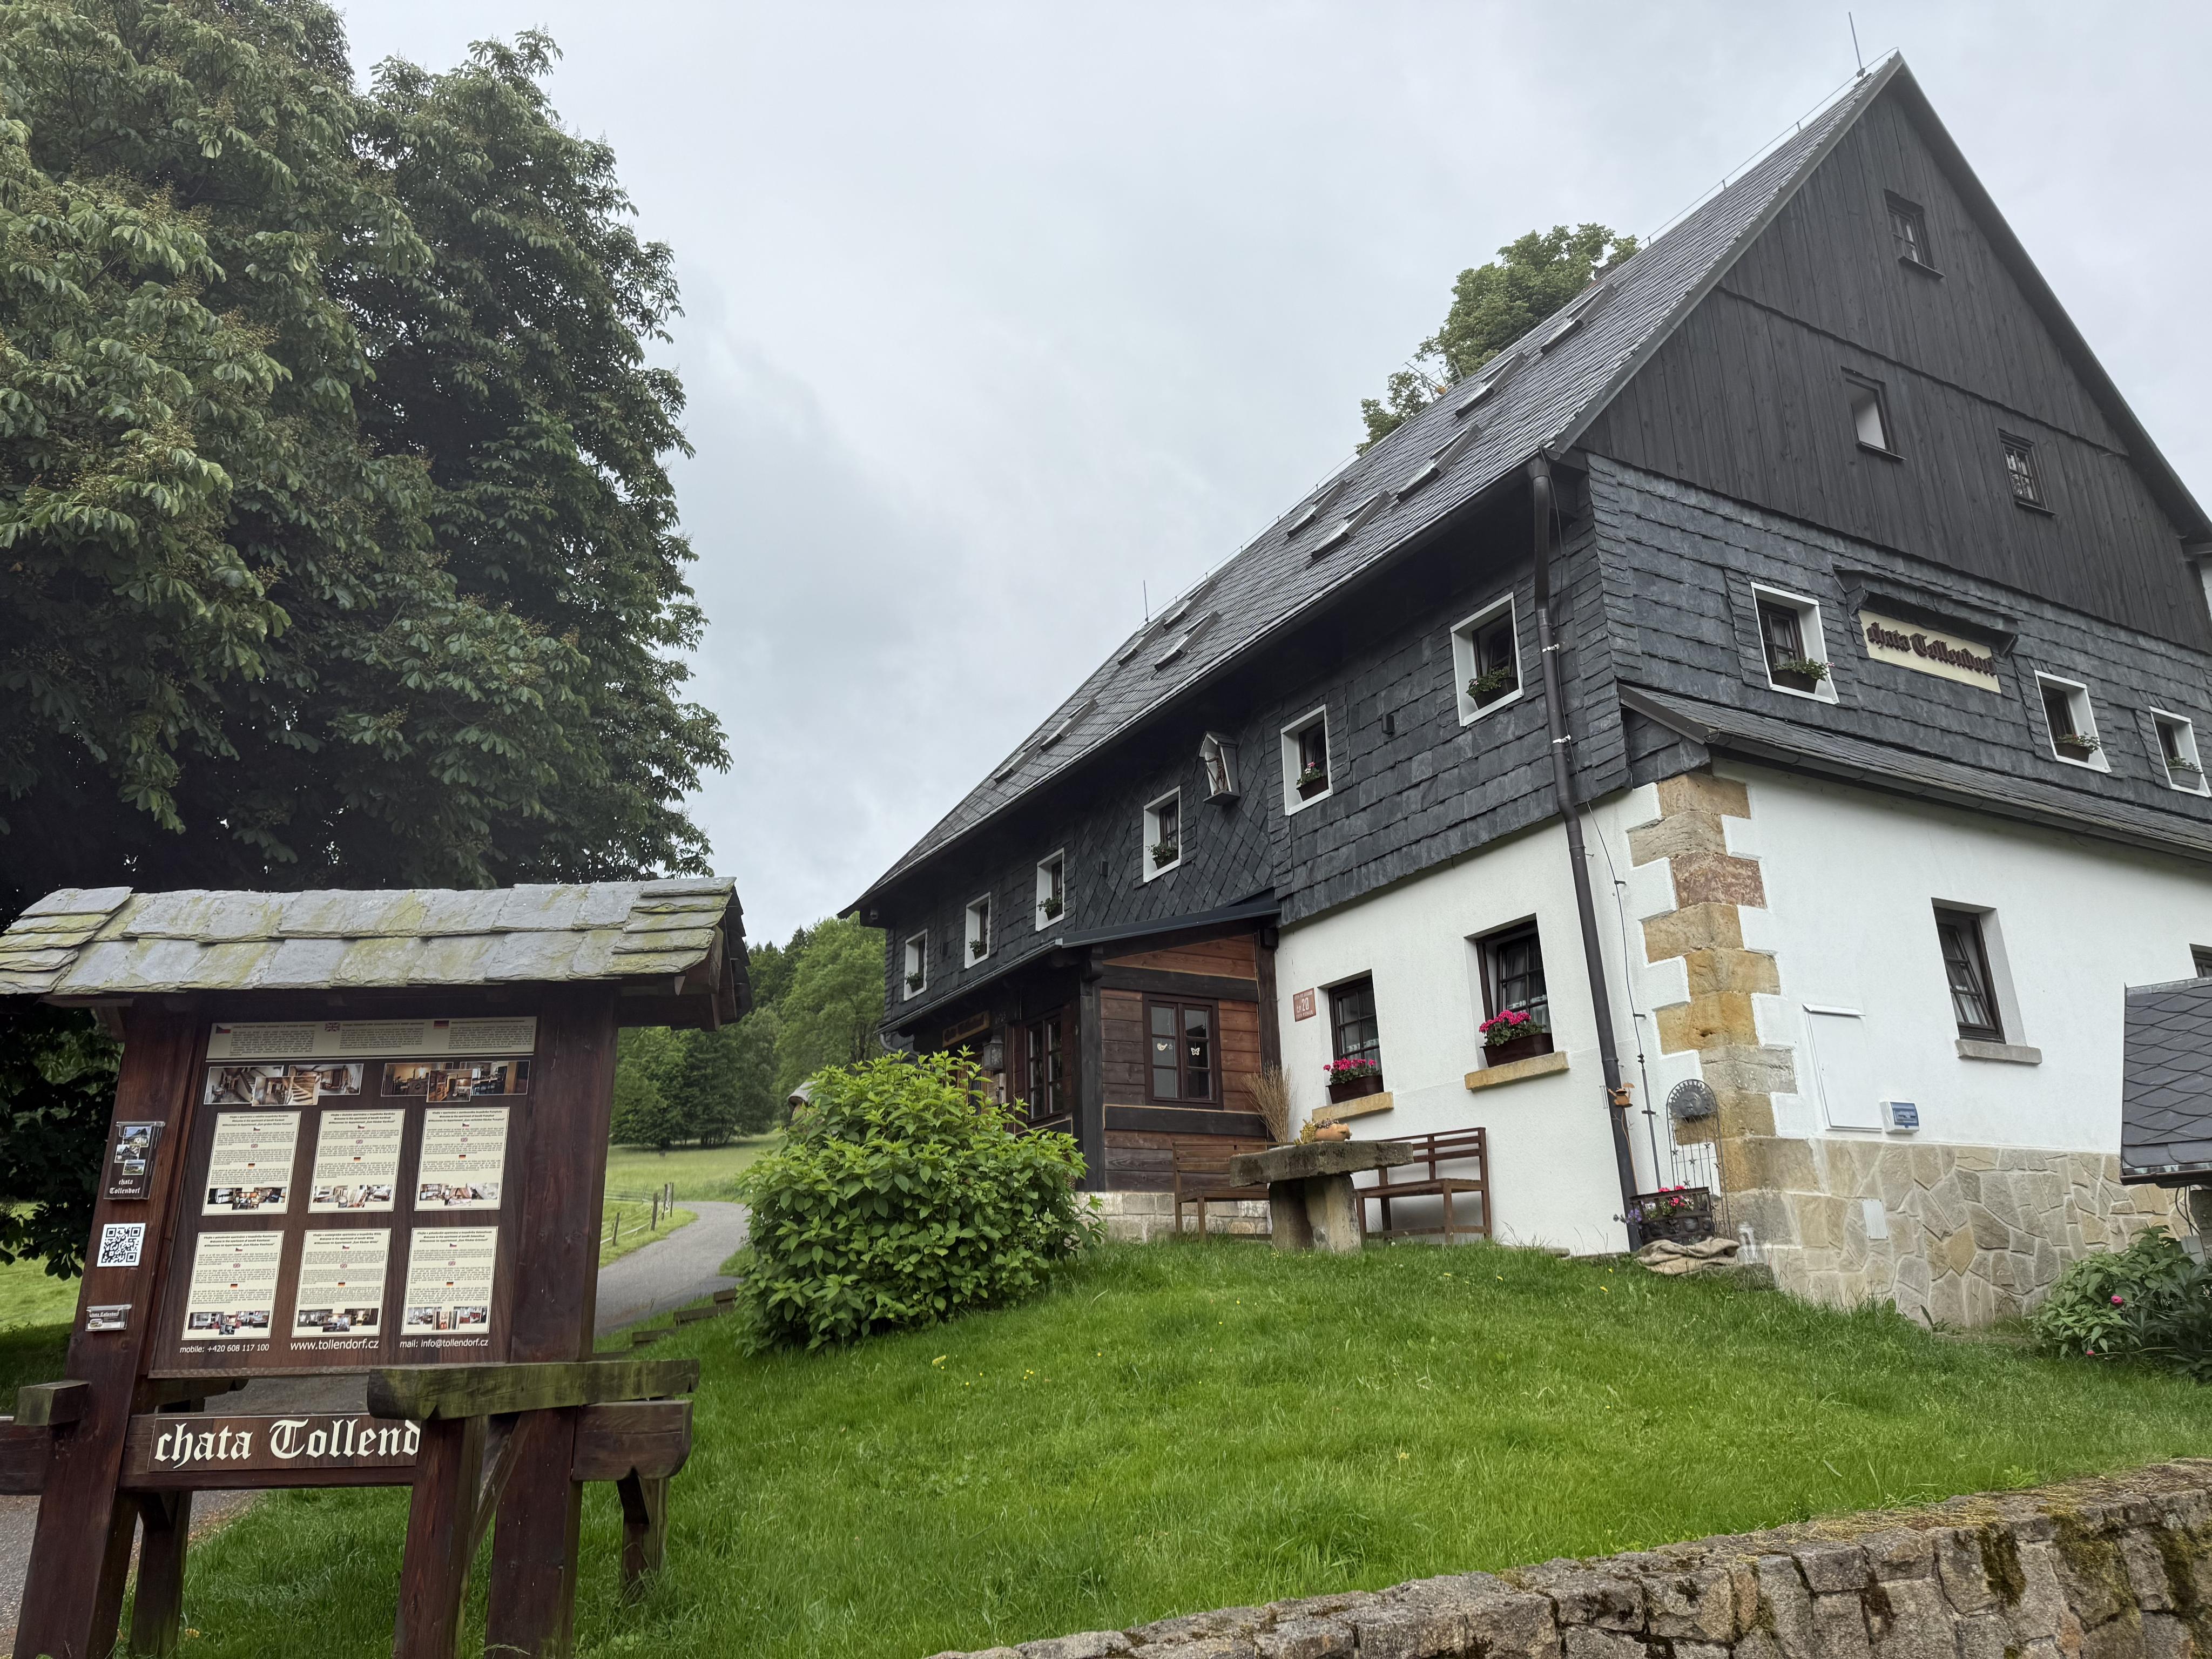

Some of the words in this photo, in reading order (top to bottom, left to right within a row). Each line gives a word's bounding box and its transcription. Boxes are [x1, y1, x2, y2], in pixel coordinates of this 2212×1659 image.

[1301, 997, 1309, 1011] 20
[180, 1345, 205, 1353] mobile:
[291, 1338, 379, 1350] www.tollendorf.cz
[400, 1339, 418, 1348] mail:
[421, 1338, 488, 1348] info@tollendorf.cz
[154, 1422, 253, 1469] chata
[269, 1418, 421, 1459] Tollend
